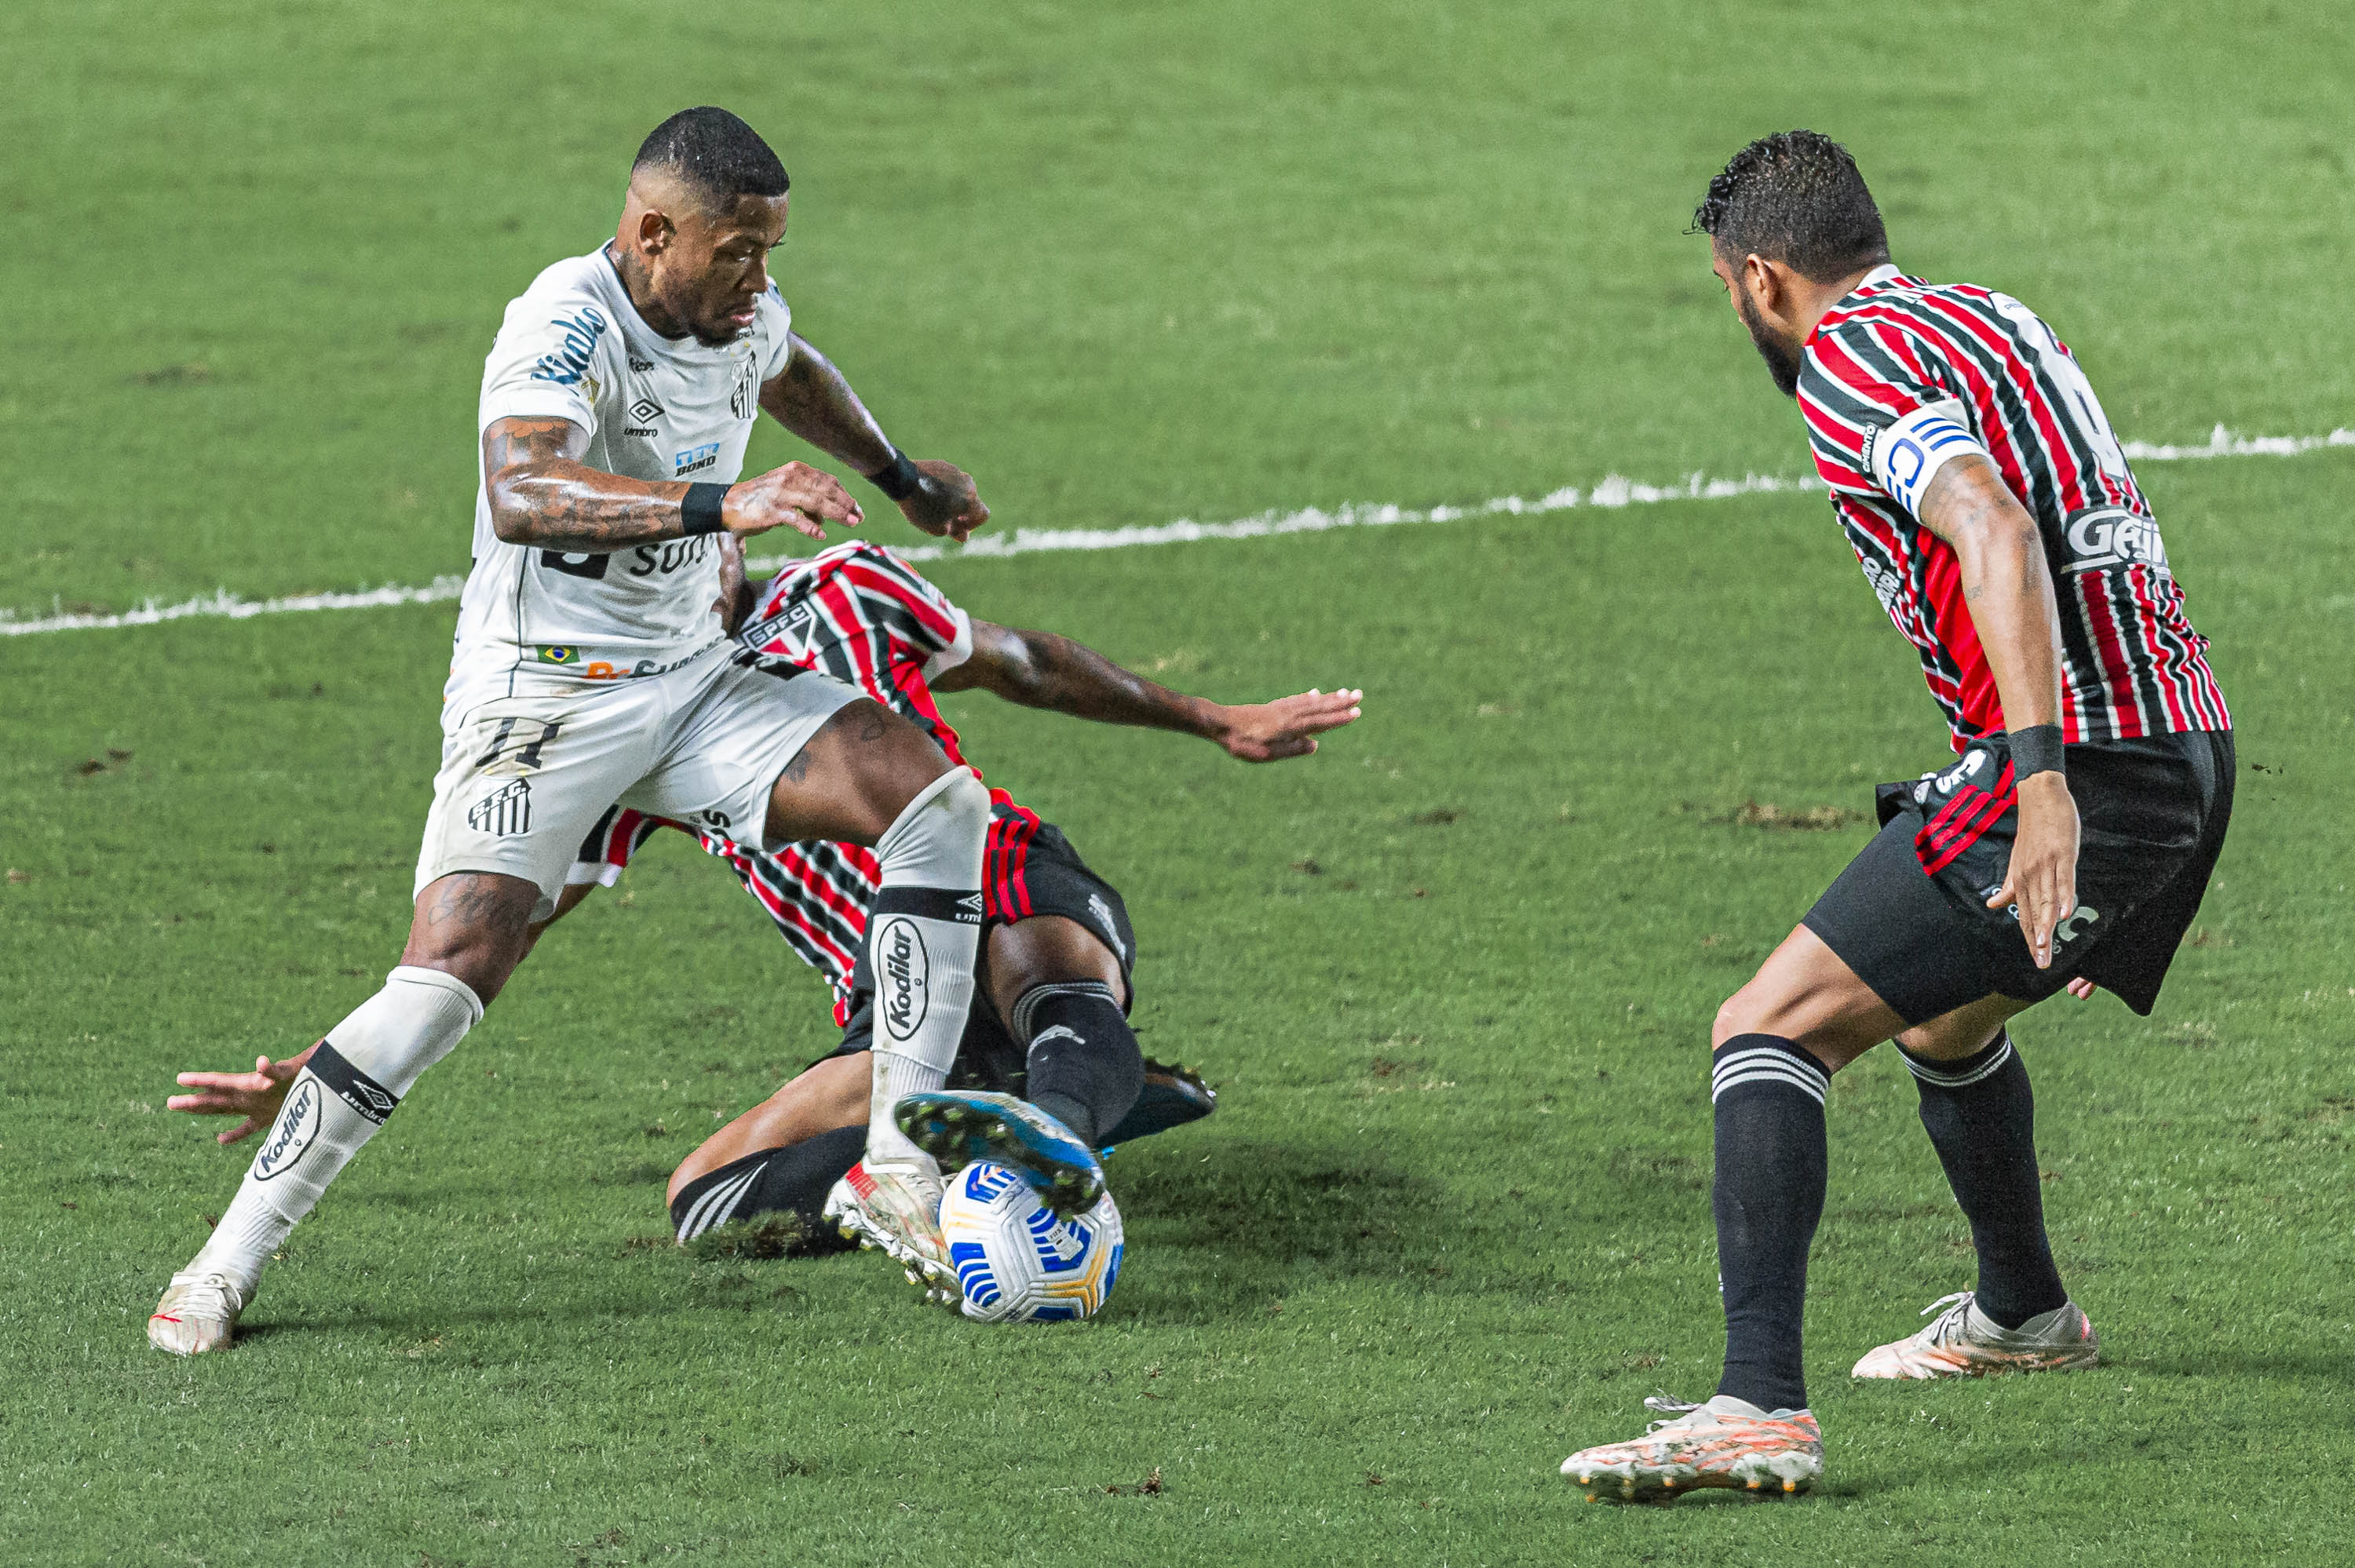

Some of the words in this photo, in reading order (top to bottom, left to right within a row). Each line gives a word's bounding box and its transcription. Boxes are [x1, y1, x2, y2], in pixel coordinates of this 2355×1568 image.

[675, 455, 717, 477] BOND
[1861, 425, 1876, 473] CIMENTO
[1888, 438, 1925, 489] C
[750, 607, 807, 644] SPFC
[475, 717, 564, 770] 11
[886, 924, 911, 1030] Kodilar
[261, 1084, 312, 1172] Kodilar
